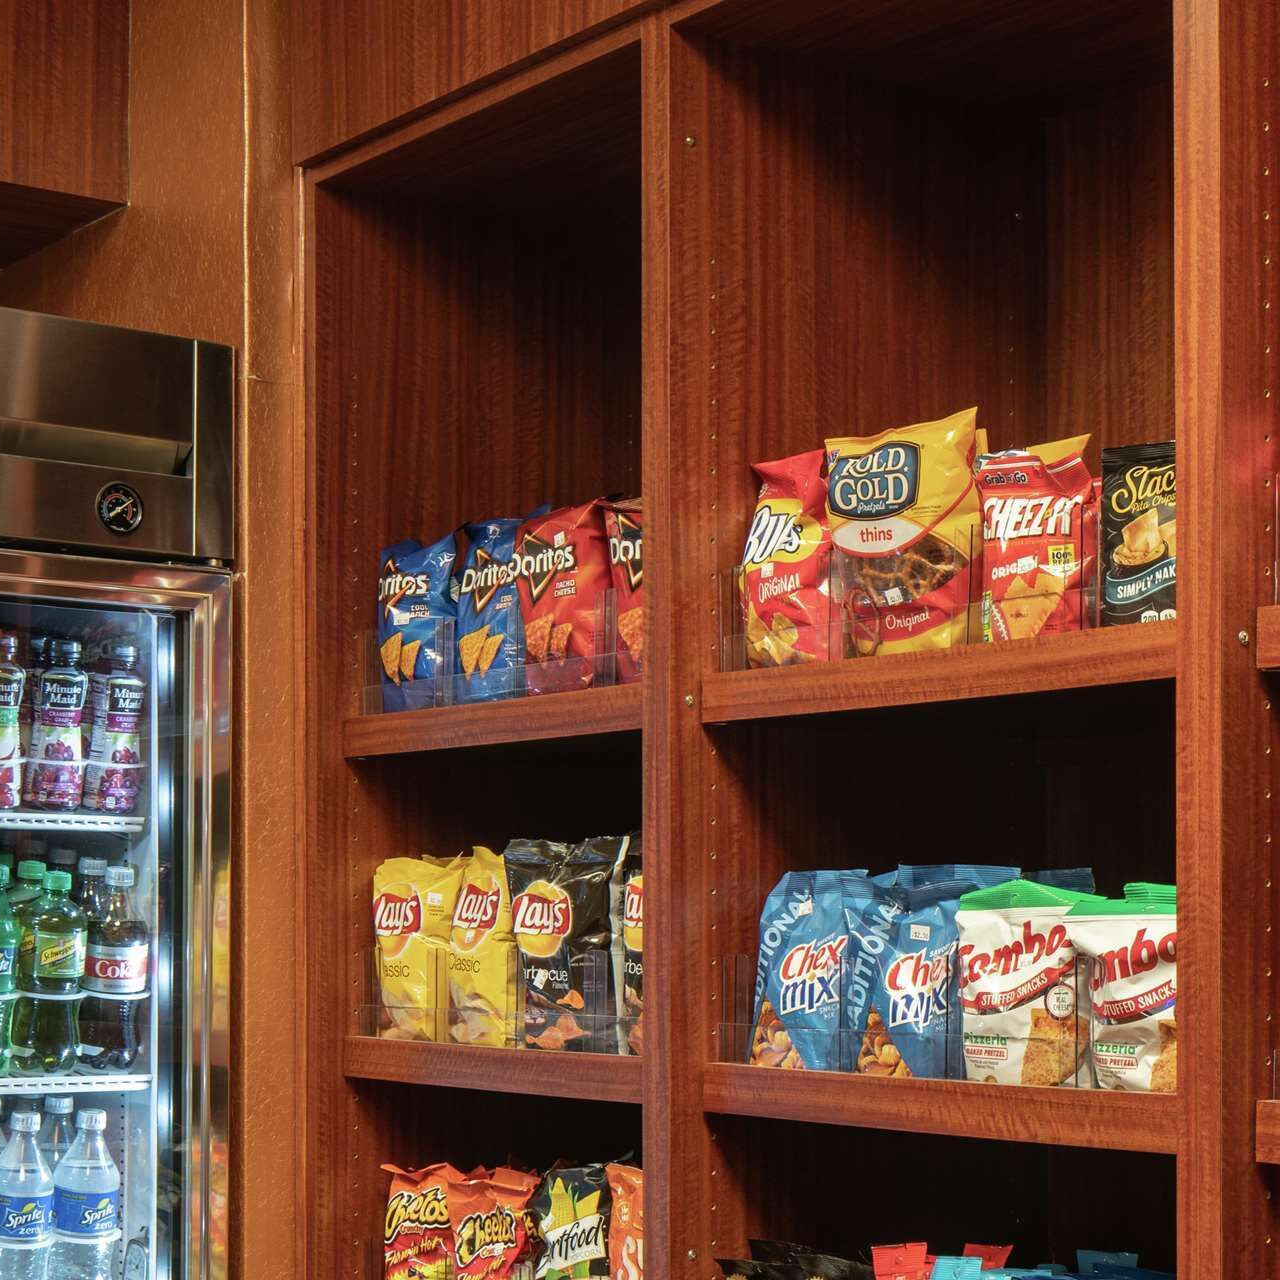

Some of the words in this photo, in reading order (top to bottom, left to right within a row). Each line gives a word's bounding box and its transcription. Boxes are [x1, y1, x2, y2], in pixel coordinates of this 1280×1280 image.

[842, 447, 905, 476] ROLD
[835, 473, 910, 506] GOLD
[984, 474, 1005, 485] Grab
[860, 527, 893, 543] thins
[512, 544, 575, 576] Doritos
[461, 562, 515, 594] Doritos
[555, 580, 575, 589] NACHO
[1118, 575, 1151, 599] SIMPLY
[554, 587, 576, 597] CHEESE
[885, 610, 930, 631] Original
[45, 683, 81, 694] Minute
[50, 692, 76, 704] Maid
[376, 895, 418, 935] Lay's
[453, 891, 499, 928] Lay's
[515, 897, 568, 935] Lay's
[448, 953, 480, 974] Classic
[781, 937, 847, 981] Chex
[981, 989, 1014, 1007] STUFFED
[1017, 975, 1048, 998] SNACKS
[1138, 981, 1176, 1007] SNACKS
[963, 1033, 1008, 1046] Pizzeria
[986, 1049, 1006, 1059] PRETZEL
[5, 1209, 45, 1228] Sprite
[82, 1205, 115, 1224] Sprite
